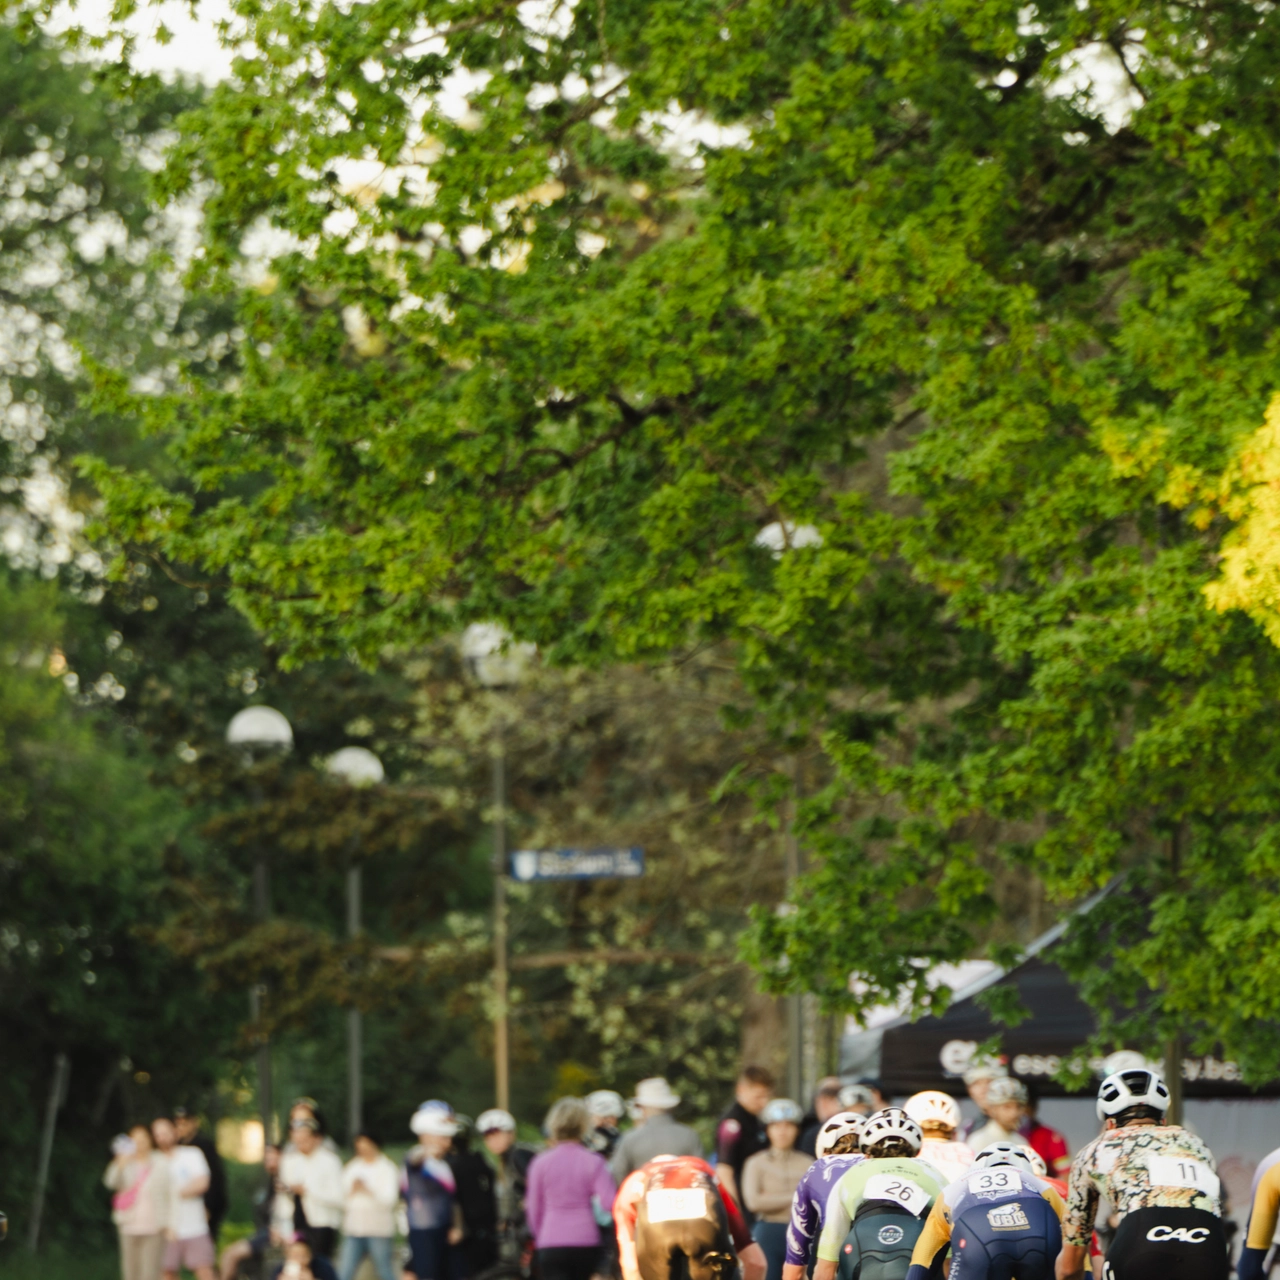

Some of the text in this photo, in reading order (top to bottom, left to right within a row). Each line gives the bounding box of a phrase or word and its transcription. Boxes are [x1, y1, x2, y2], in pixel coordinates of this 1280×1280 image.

[980, 1172, 1009, 1189] 33
[1177, 1162, 1198, 1182] 11
[884, 1181, 915, 1202] 26
[987, 1210, 1029, 1227] UBC
[1146, 1225, 1211, 1244] CAC
